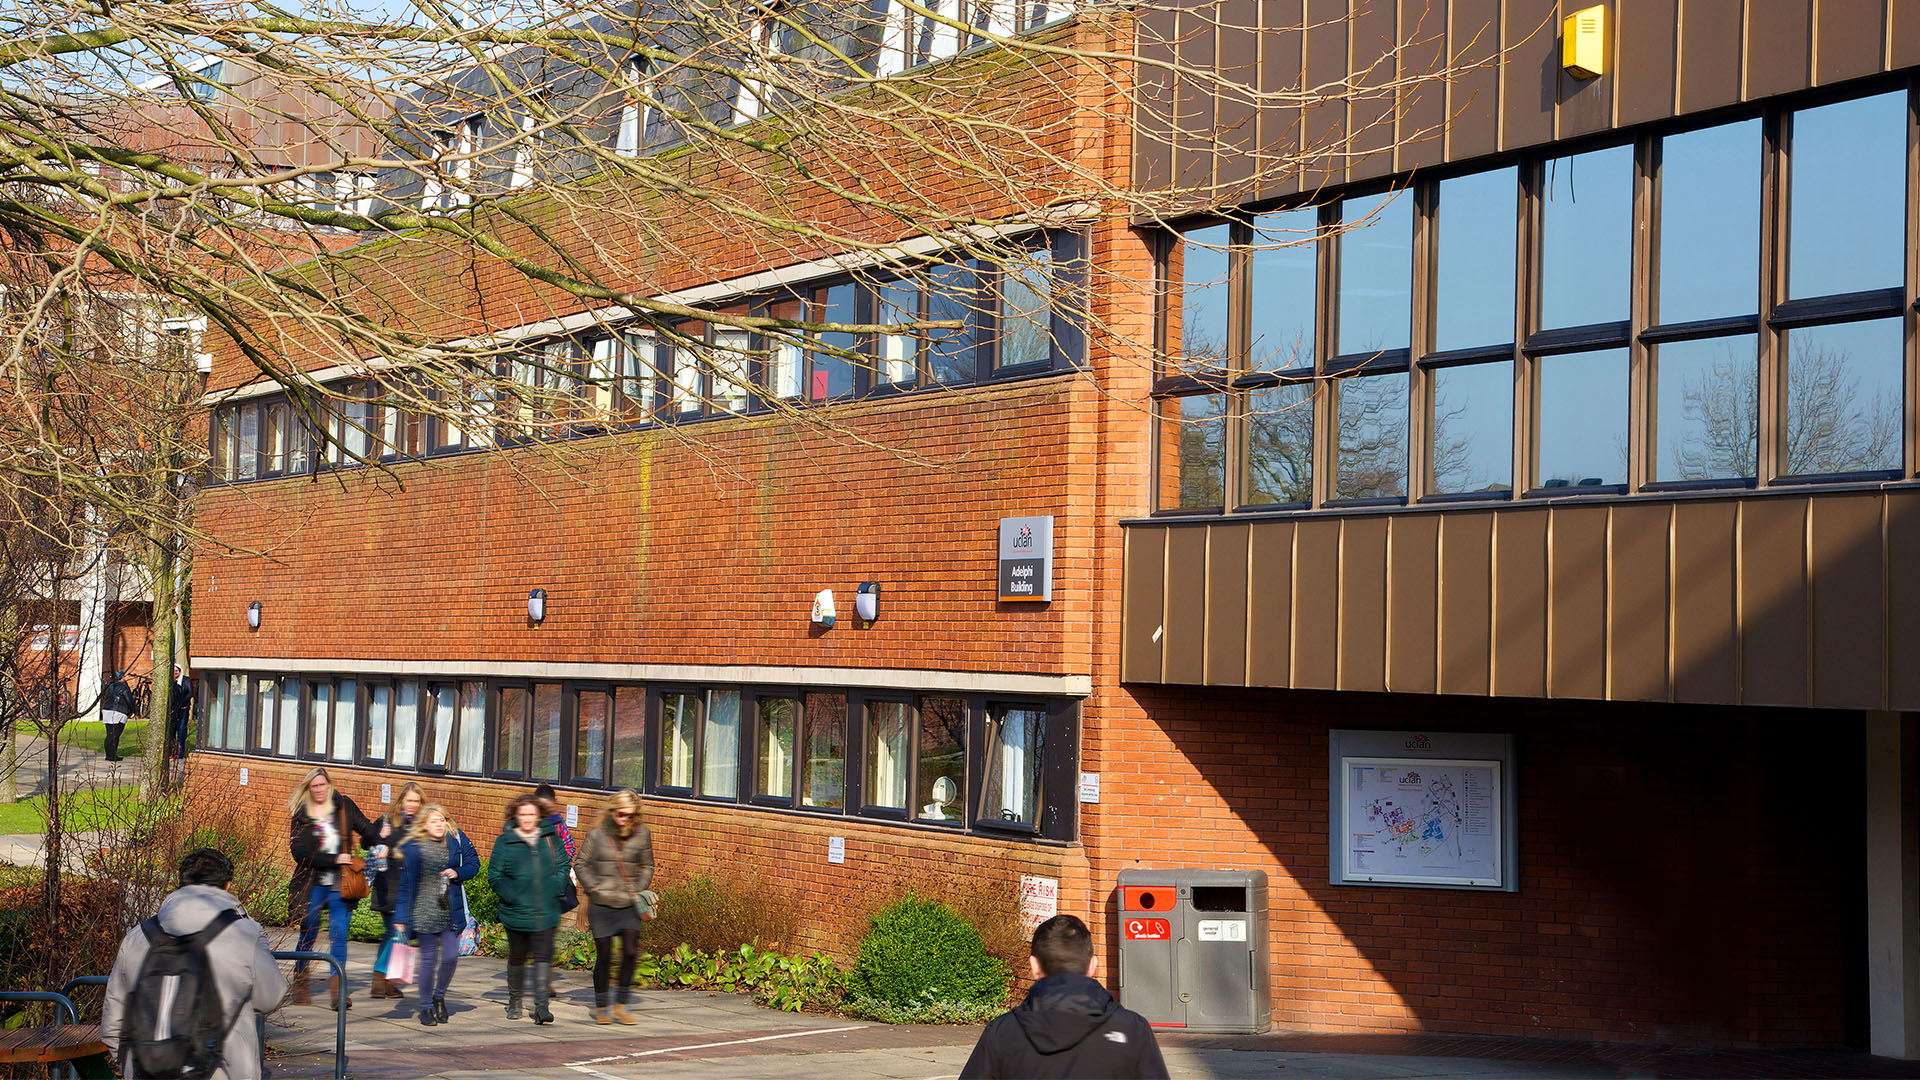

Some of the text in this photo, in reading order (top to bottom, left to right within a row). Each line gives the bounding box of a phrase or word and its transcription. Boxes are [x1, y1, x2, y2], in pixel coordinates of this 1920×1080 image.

[1013, 535, 1032, 548] uclan
[1011, 565, 1033, 579] Adelphi
[1010, 581, 1033, 595] Building
[1405, 736, 1431, 749] uclan
[1399, 775, 1421, 784] uclan
[1038, 884, 1054, 897] RISK
